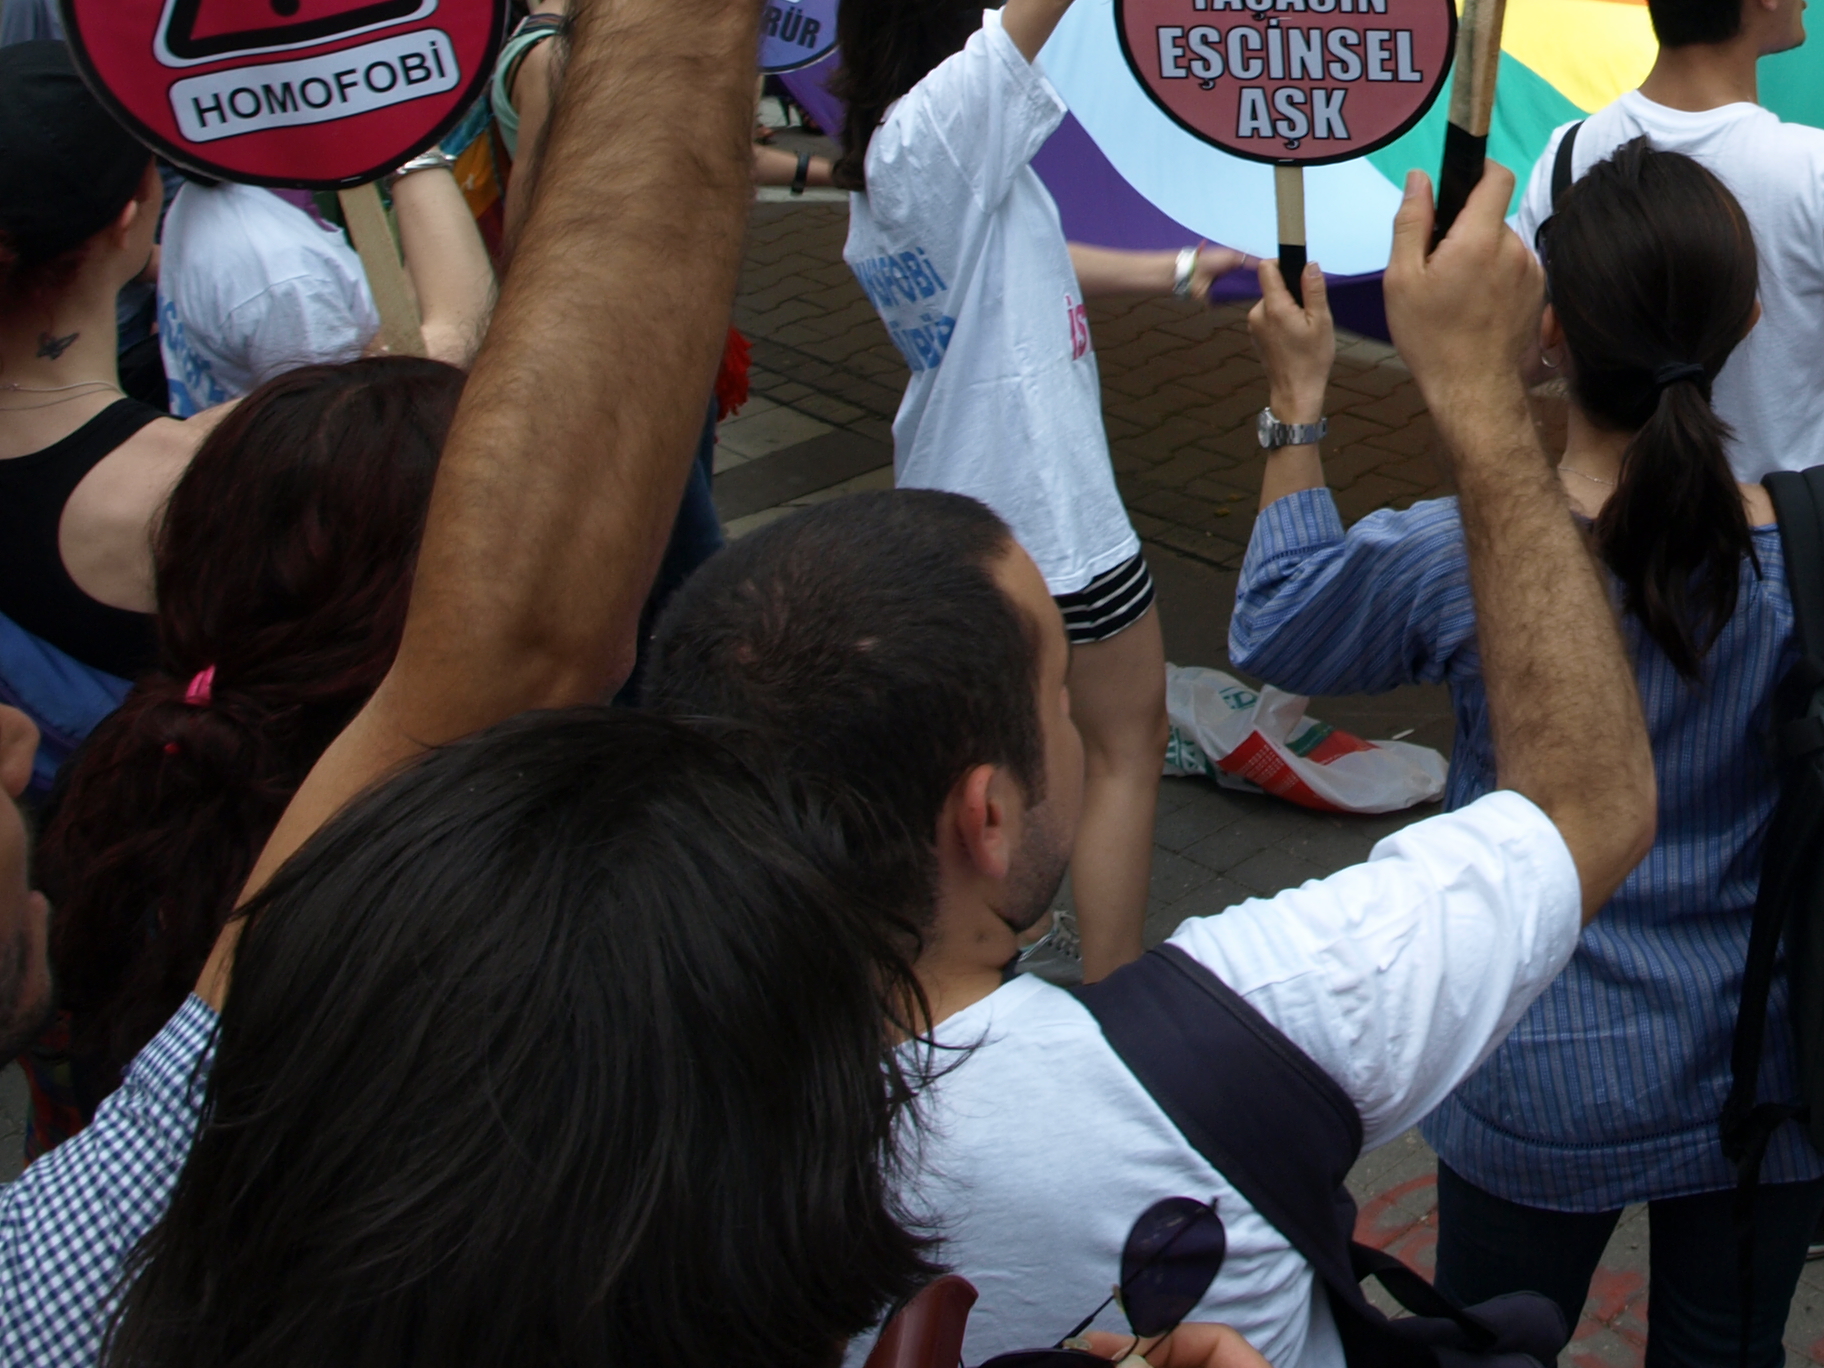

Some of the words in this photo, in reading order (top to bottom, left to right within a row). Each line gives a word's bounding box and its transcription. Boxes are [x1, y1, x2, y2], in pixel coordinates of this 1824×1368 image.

[765, 6, 821, 49] RÜR
[1156, 17, 1424, 91] EŞCİNSEL
[191, 41, 447, 129] HOMOFOBİ
[1235, 86, 1352, 150] AŞK
